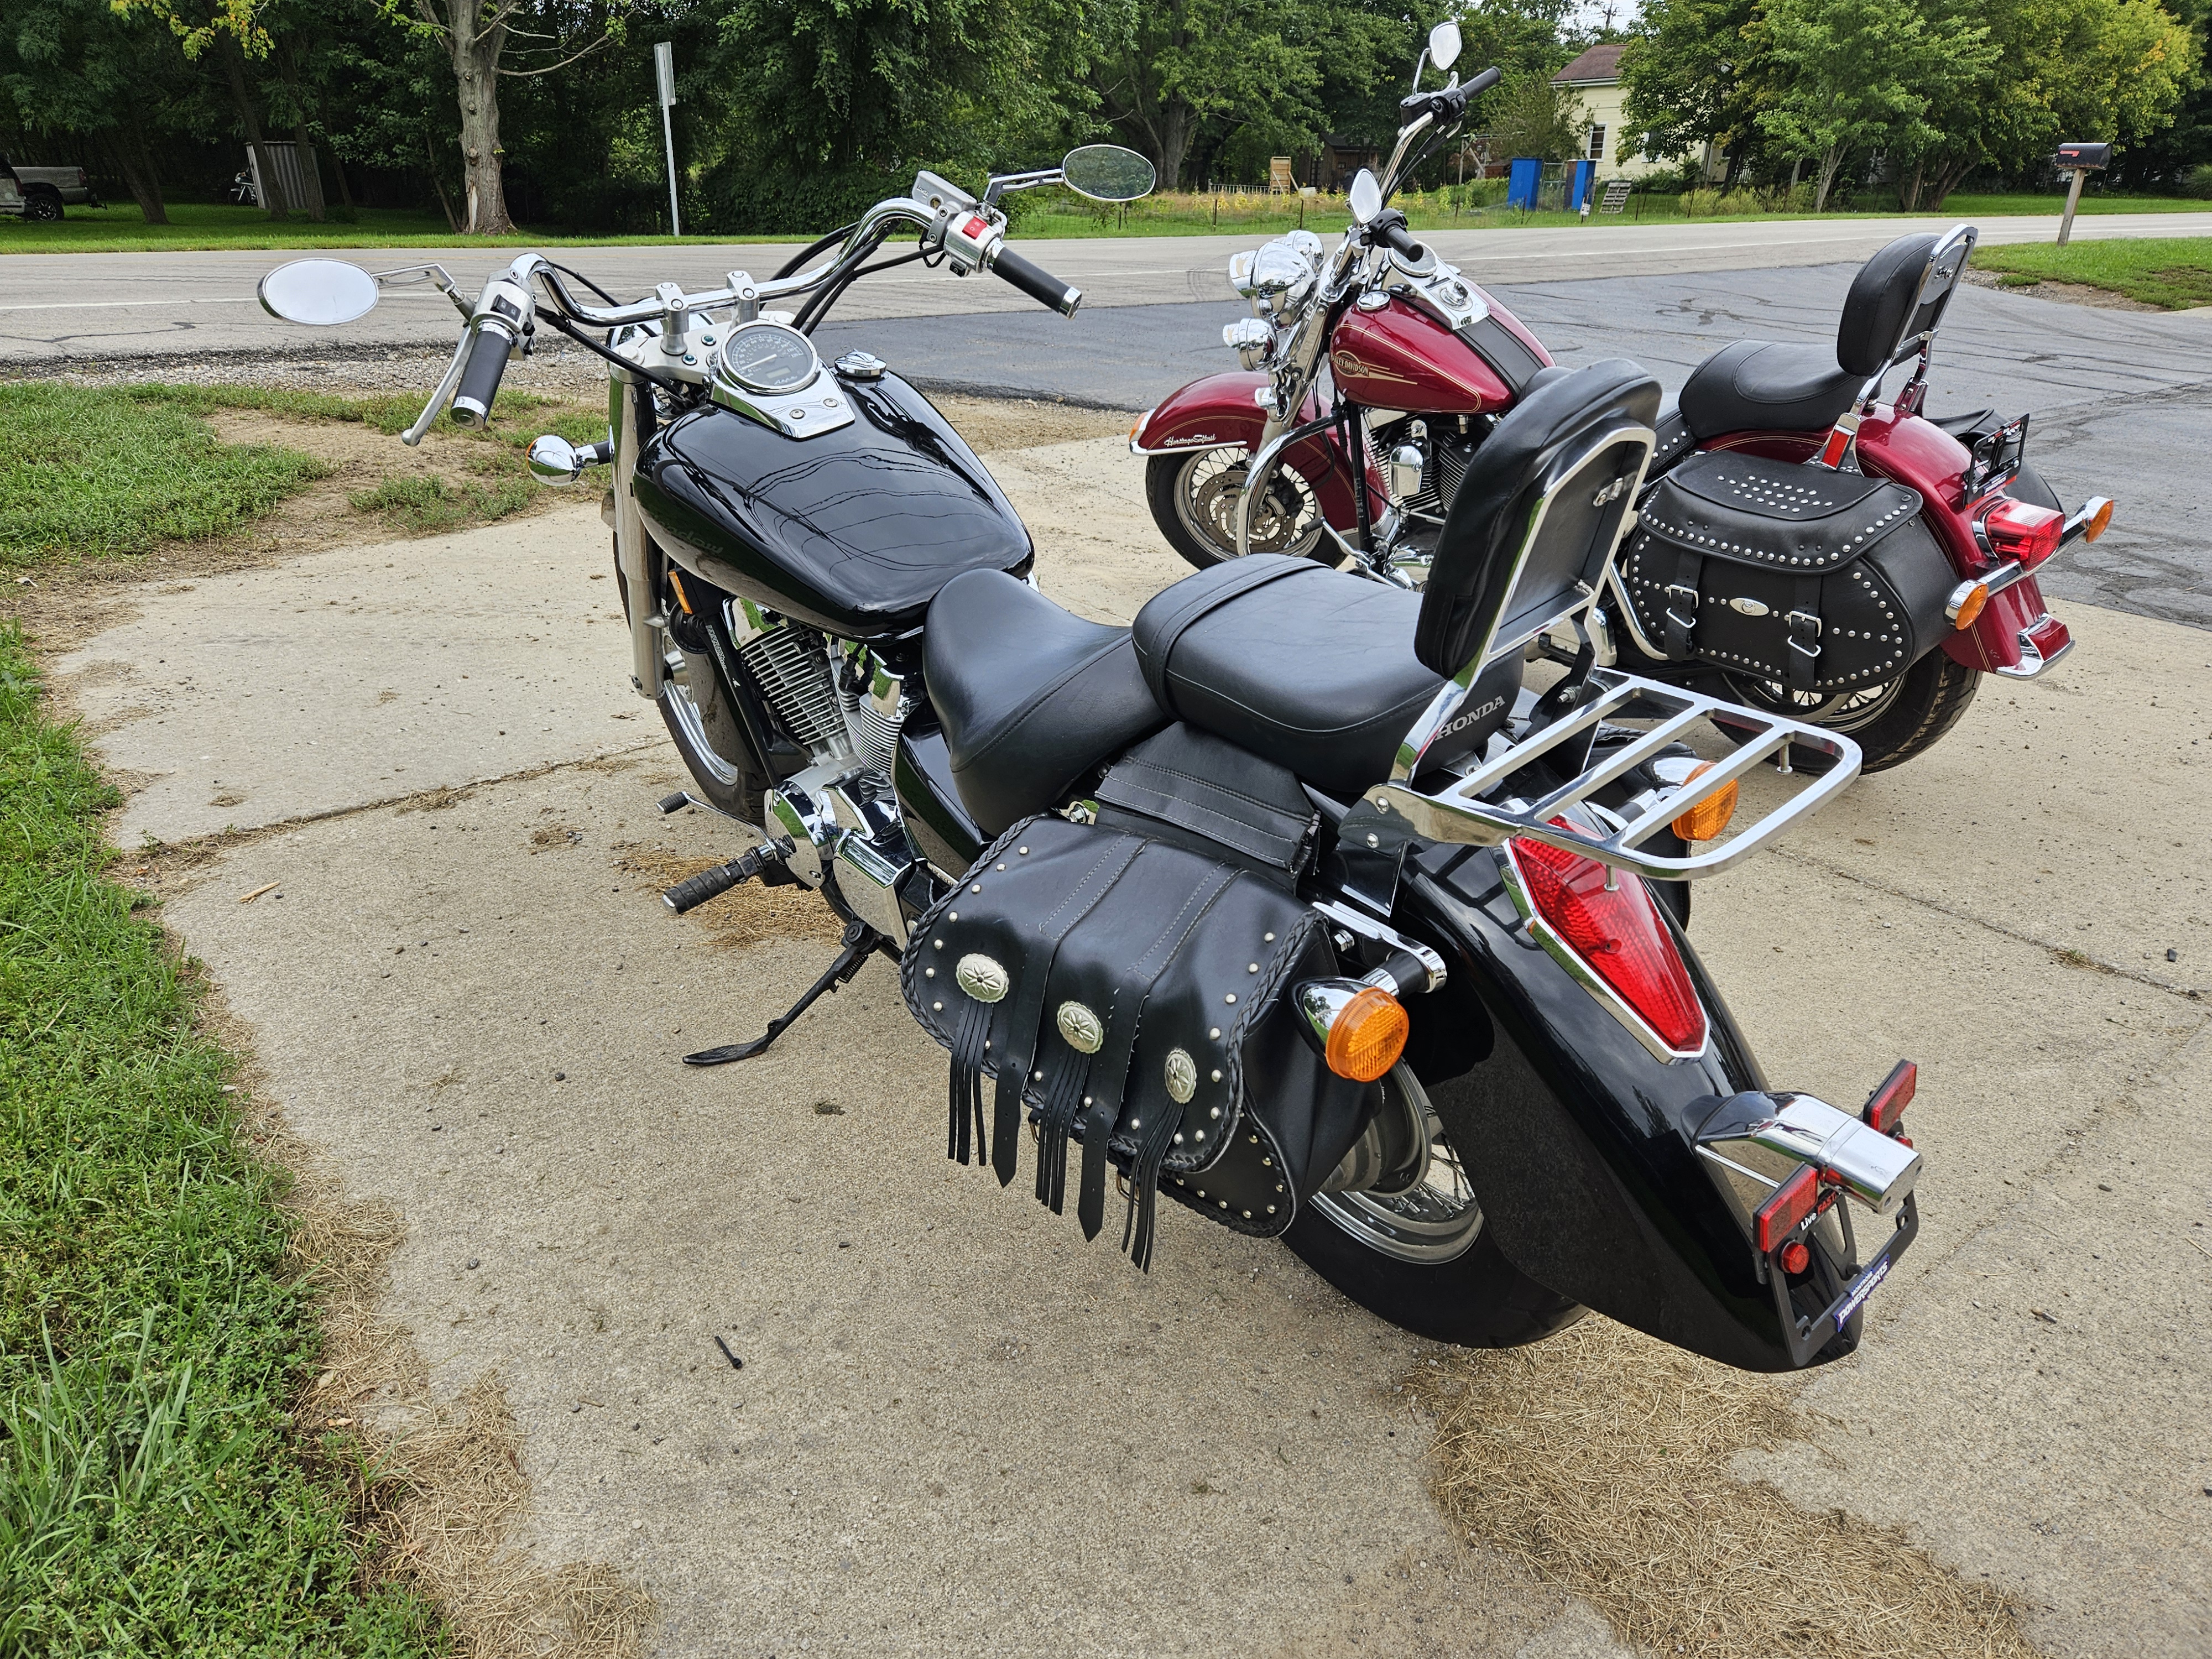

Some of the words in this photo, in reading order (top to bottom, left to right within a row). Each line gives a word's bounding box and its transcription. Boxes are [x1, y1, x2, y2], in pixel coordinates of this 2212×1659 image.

[1434, 695, 1505, 741] HONDA
[1800, 1212, 1817, 1231] Live
[1838, 1260, 1888, 1325] POWERSPORTS
